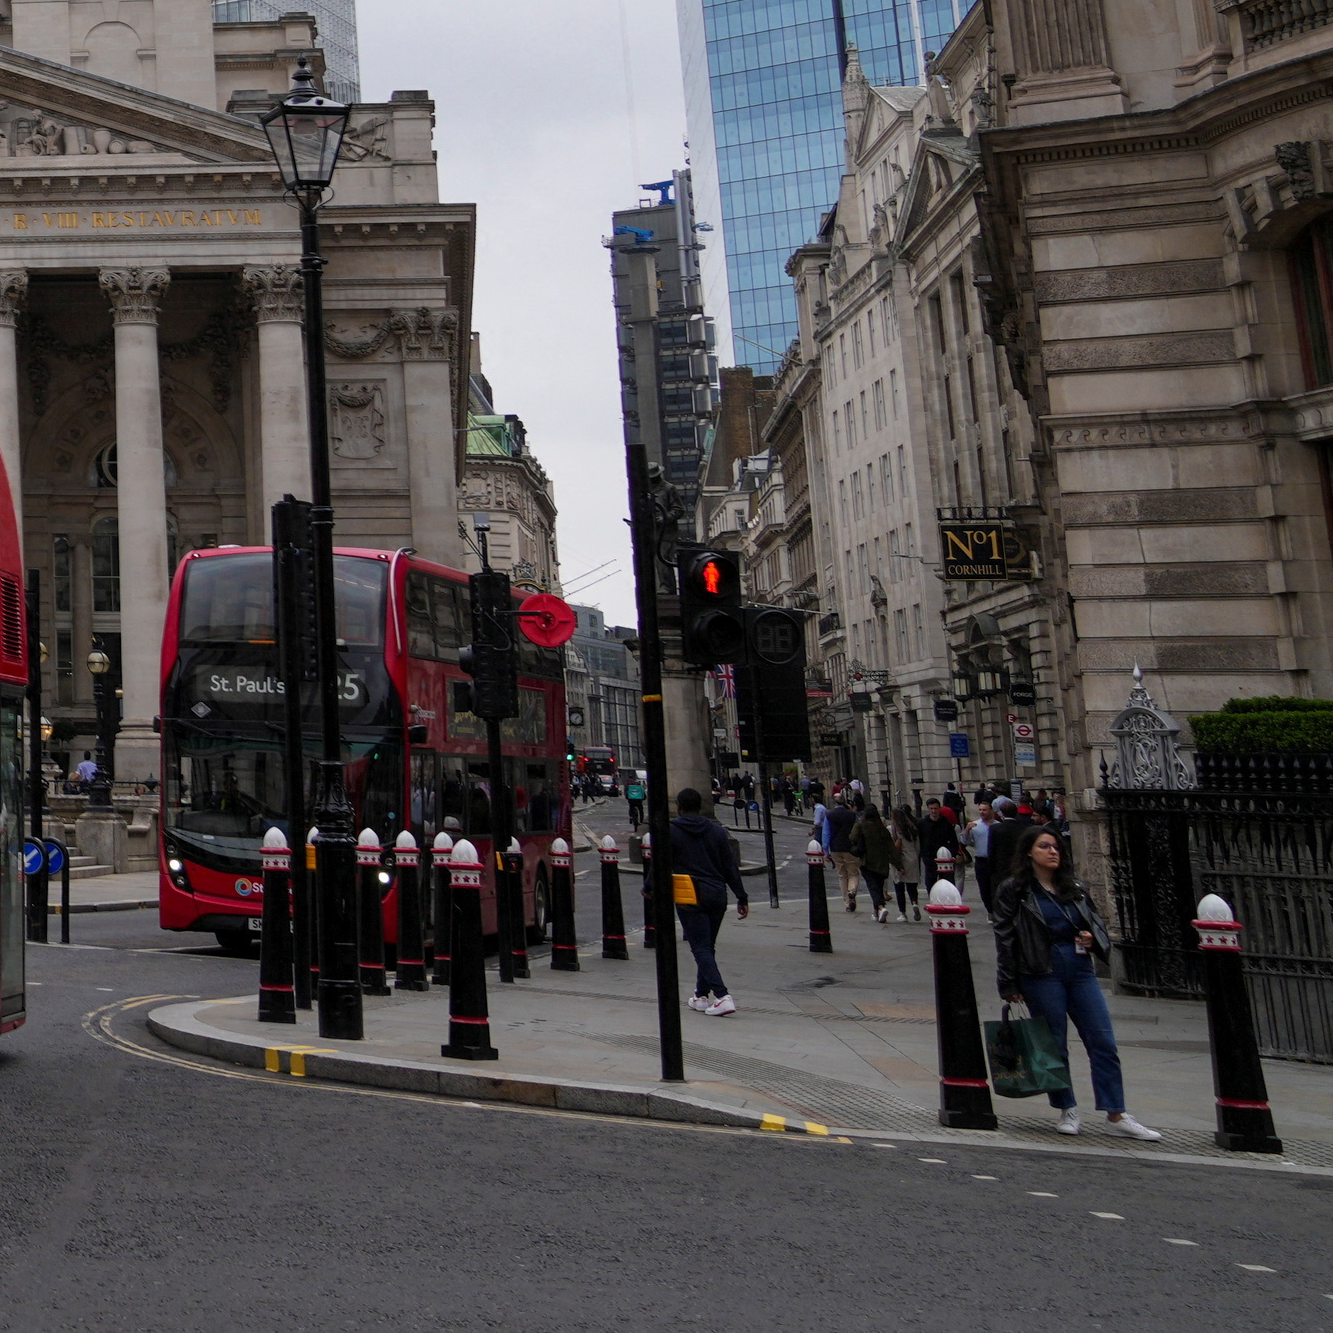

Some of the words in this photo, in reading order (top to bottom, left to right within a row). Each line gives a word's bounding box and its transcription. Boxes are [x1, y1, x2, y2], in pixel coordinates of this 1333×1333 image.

[14, 213, 30, 230] R
[42, 212, 79, 228] VIII
[92, 209, 262, 228] RESTAVRATVM
[948, 564, 1003, 576] CORNHILL
[210, 674, 234, 692] St.
[237, 675, 286, 694] Paul's
